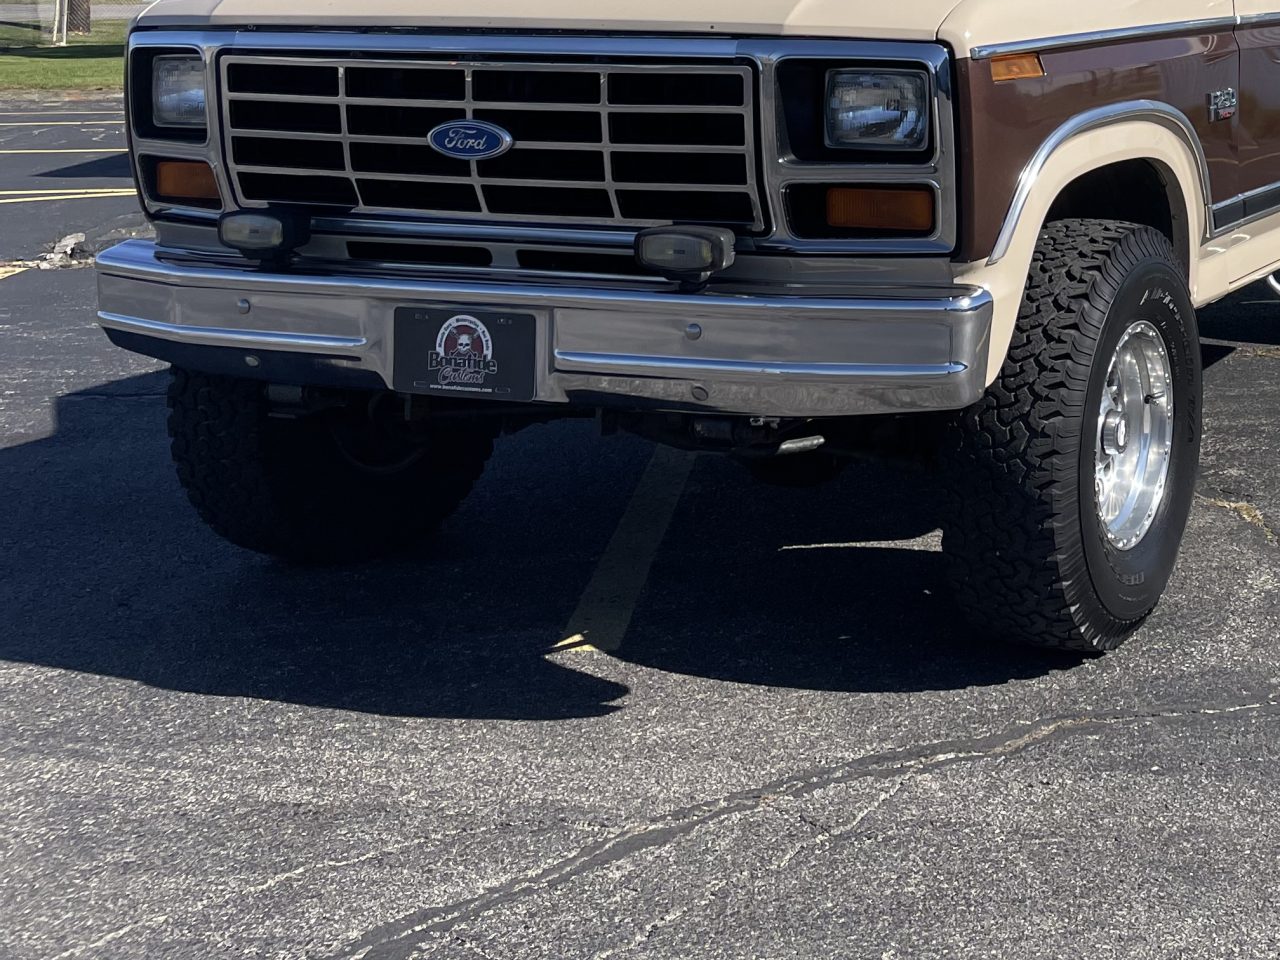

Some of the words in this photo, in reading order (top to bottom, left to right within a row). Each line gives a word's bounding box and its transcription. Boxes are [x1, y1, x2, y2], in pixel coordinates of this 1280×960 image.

[444, 127, 488, 150] Ford
[428, 350, 498, 374] Bonafide
[438, 365, 486, 385] Customs
